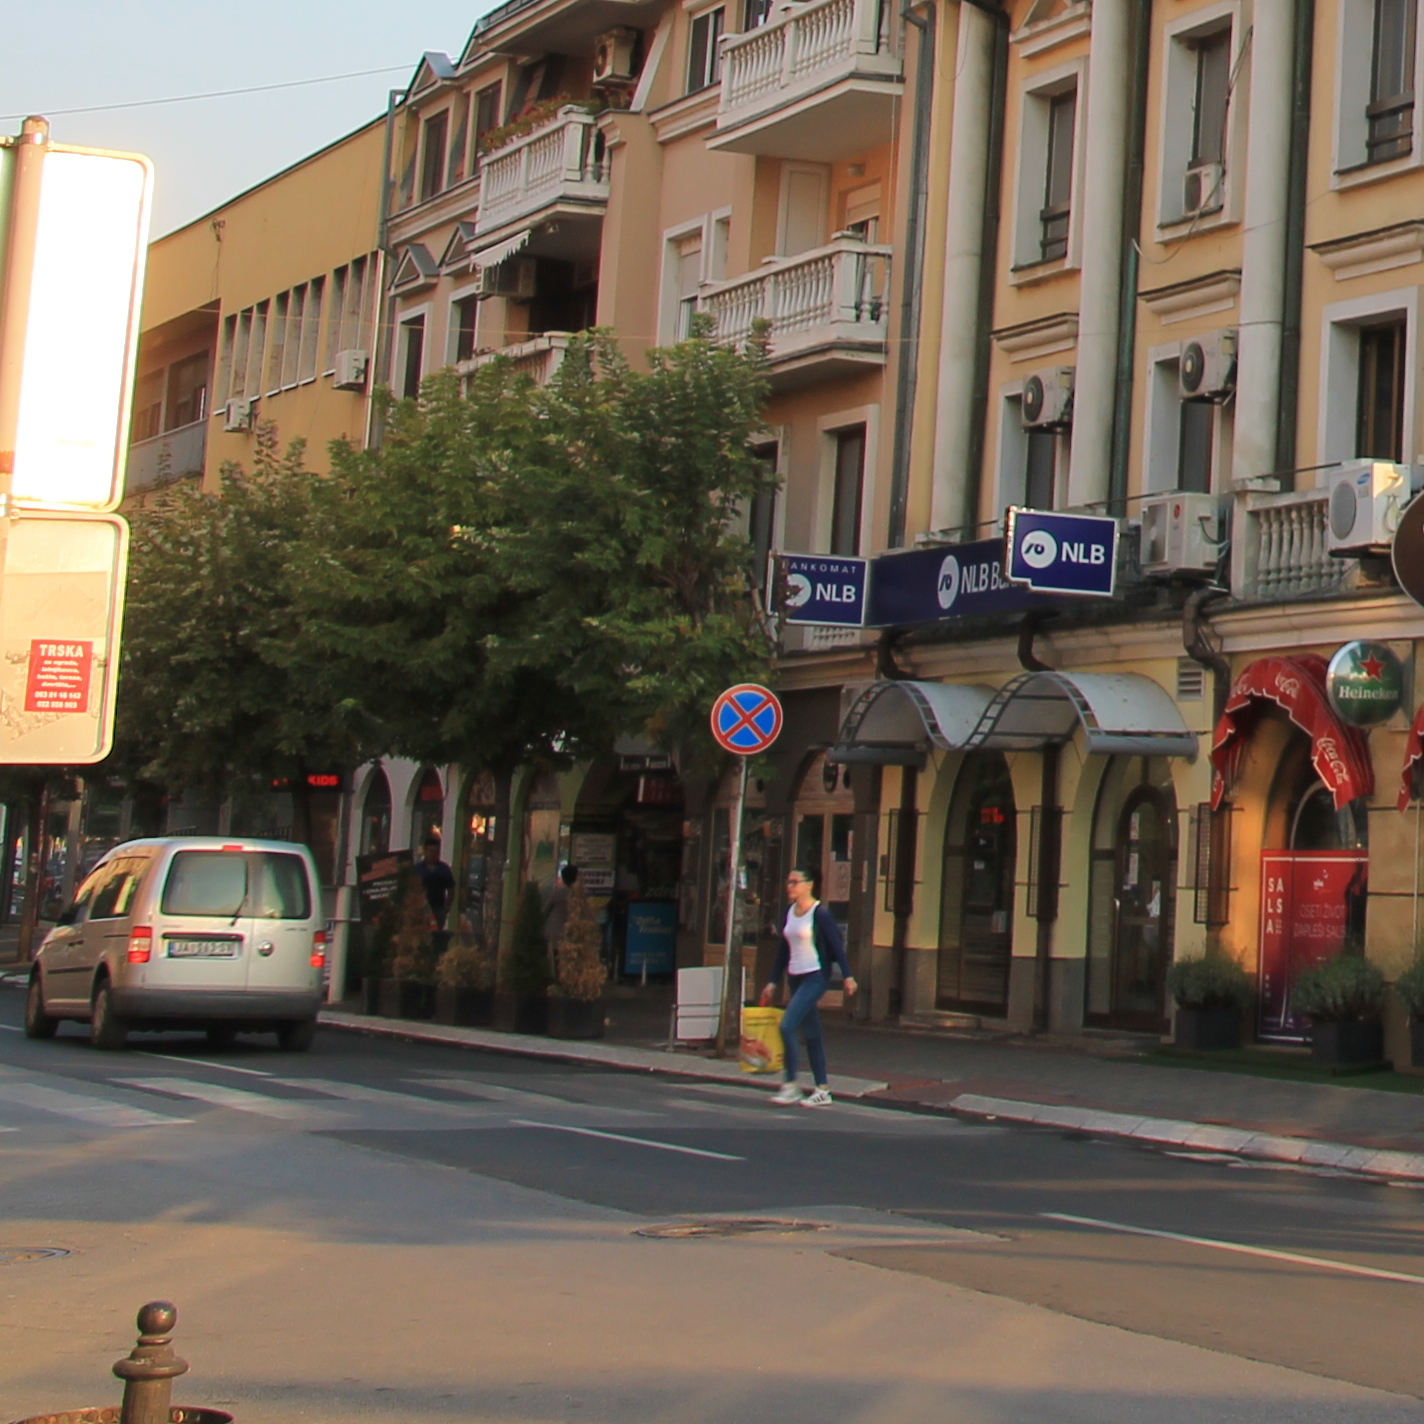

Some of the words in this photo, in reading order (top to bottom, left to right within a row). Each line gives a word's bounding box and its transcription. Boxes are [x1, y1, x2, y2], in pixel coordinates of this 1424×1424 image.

[1061, 541, 1105, 565] NLB
[961, 562, 989, 594] NLB
[815, 583, 856, 603] NLB
[39, 644, 84, 657] TRSKA
[1338, 685, 1398, 699] Heineken
